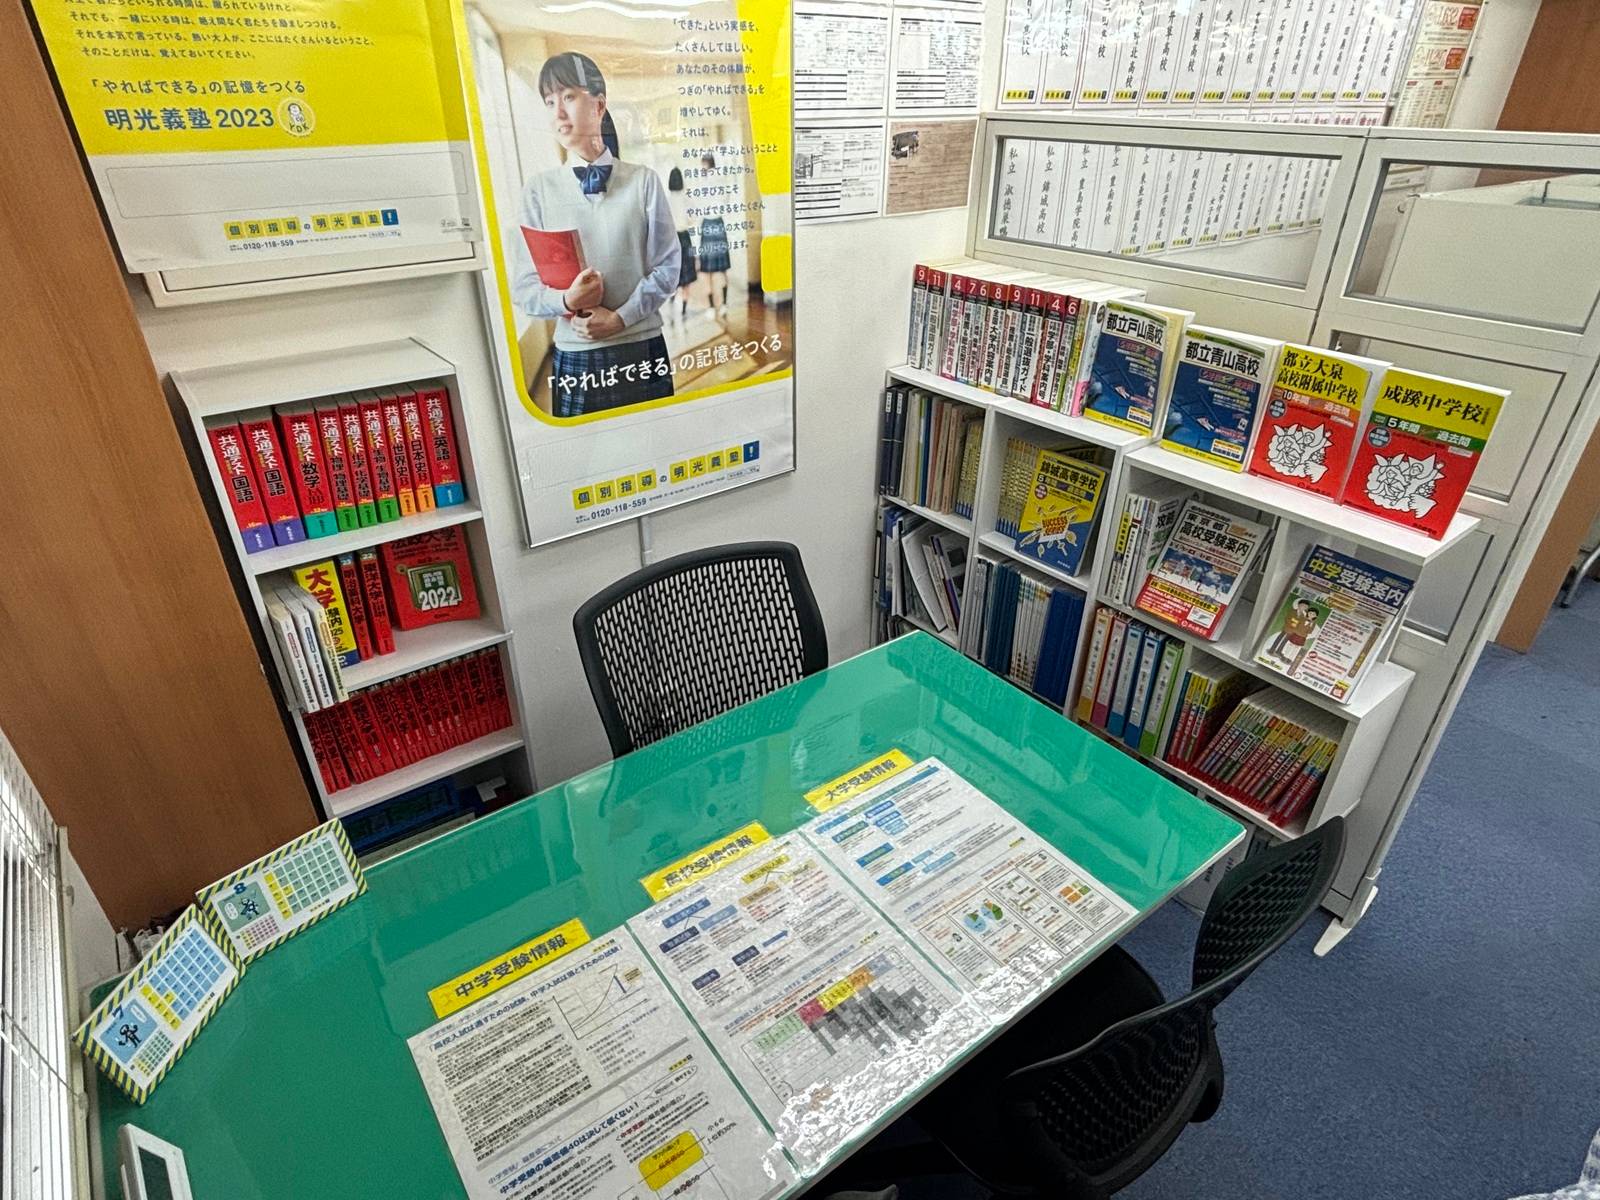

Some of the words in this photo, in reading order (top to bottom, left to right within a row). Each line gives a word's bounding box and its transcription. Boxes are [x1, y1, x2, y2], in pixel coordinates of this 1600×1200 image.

[93, 79, 306, 95] 「やればできる」の記憶をつくる
[678, 85, 765, 97] つぎの「やればできる」を
[919, 270, 925, 281] 9
[932, 274, 941, 285] 11
[954, 280, 961, 290] 4
[970, 283, 976, 294] 7
[980, 285, 987, 296] 6
[995, 288, 1002, 299] 8
[1014, 289, 1021, 300] 9
[1031, 293, 1040, 305] 11
[1052, 299, 1060, 310] 4
[1068, 302, 1076, 315] 6
[1106, 313, 1164, 348] 都立戸山高校
[548, 334, 782, 394] 「やればできる」の記憶をつくる
[1185, 339, 1260, 378] 都立青山高校
[1283, 348, 1344, 383] 都立大泉
[1277, 368, 1359, 407] 高校附属中学校
[427, 397, 447, 436] 共通テスト
[1382, 386, 1483, 424] 成蹊中学校
[343, 414, 365, 454] 共通テスト
[364, 409, 385, 449] 共通テスト
[384, 405, 404, 443] 共通テスト
[402, 402, 423, 439] 共通テスト
[1388, 417, 1421, 436] 5年間
[252, 429, 278, 469] 共通テスト
[292, 422, 315, 462] 共通テスト
[321, 417, 343, 457] 共通テスト
[434, 436, 451, 461] 英語
[1437, 430, 1470, 448] 過去問
[218, 434, 245, 476] 共通テスト
[232, 476, 254, 503] 国語
[264, 469, 286, 496] 国語
[302, 462, 321, 489] 数学
[1040, 460, 1098, 492] 錦城高等学校
[592, 498, 648, 519] 0120-118-559
[1187, 513, 1226, 531] 東京都
[1180, 521, 1250, 557] 高校受験案内
[305, 568, 337, 608] 大学
[1309, 558, 1406, 607] 中学受験案内
[419, 586, 458, 611] 2022
[825, 758, 897, 801] 大学受験情報
[234, 882, 247, 895] 8
[455, 933, 568, 999] 中学受験情報
